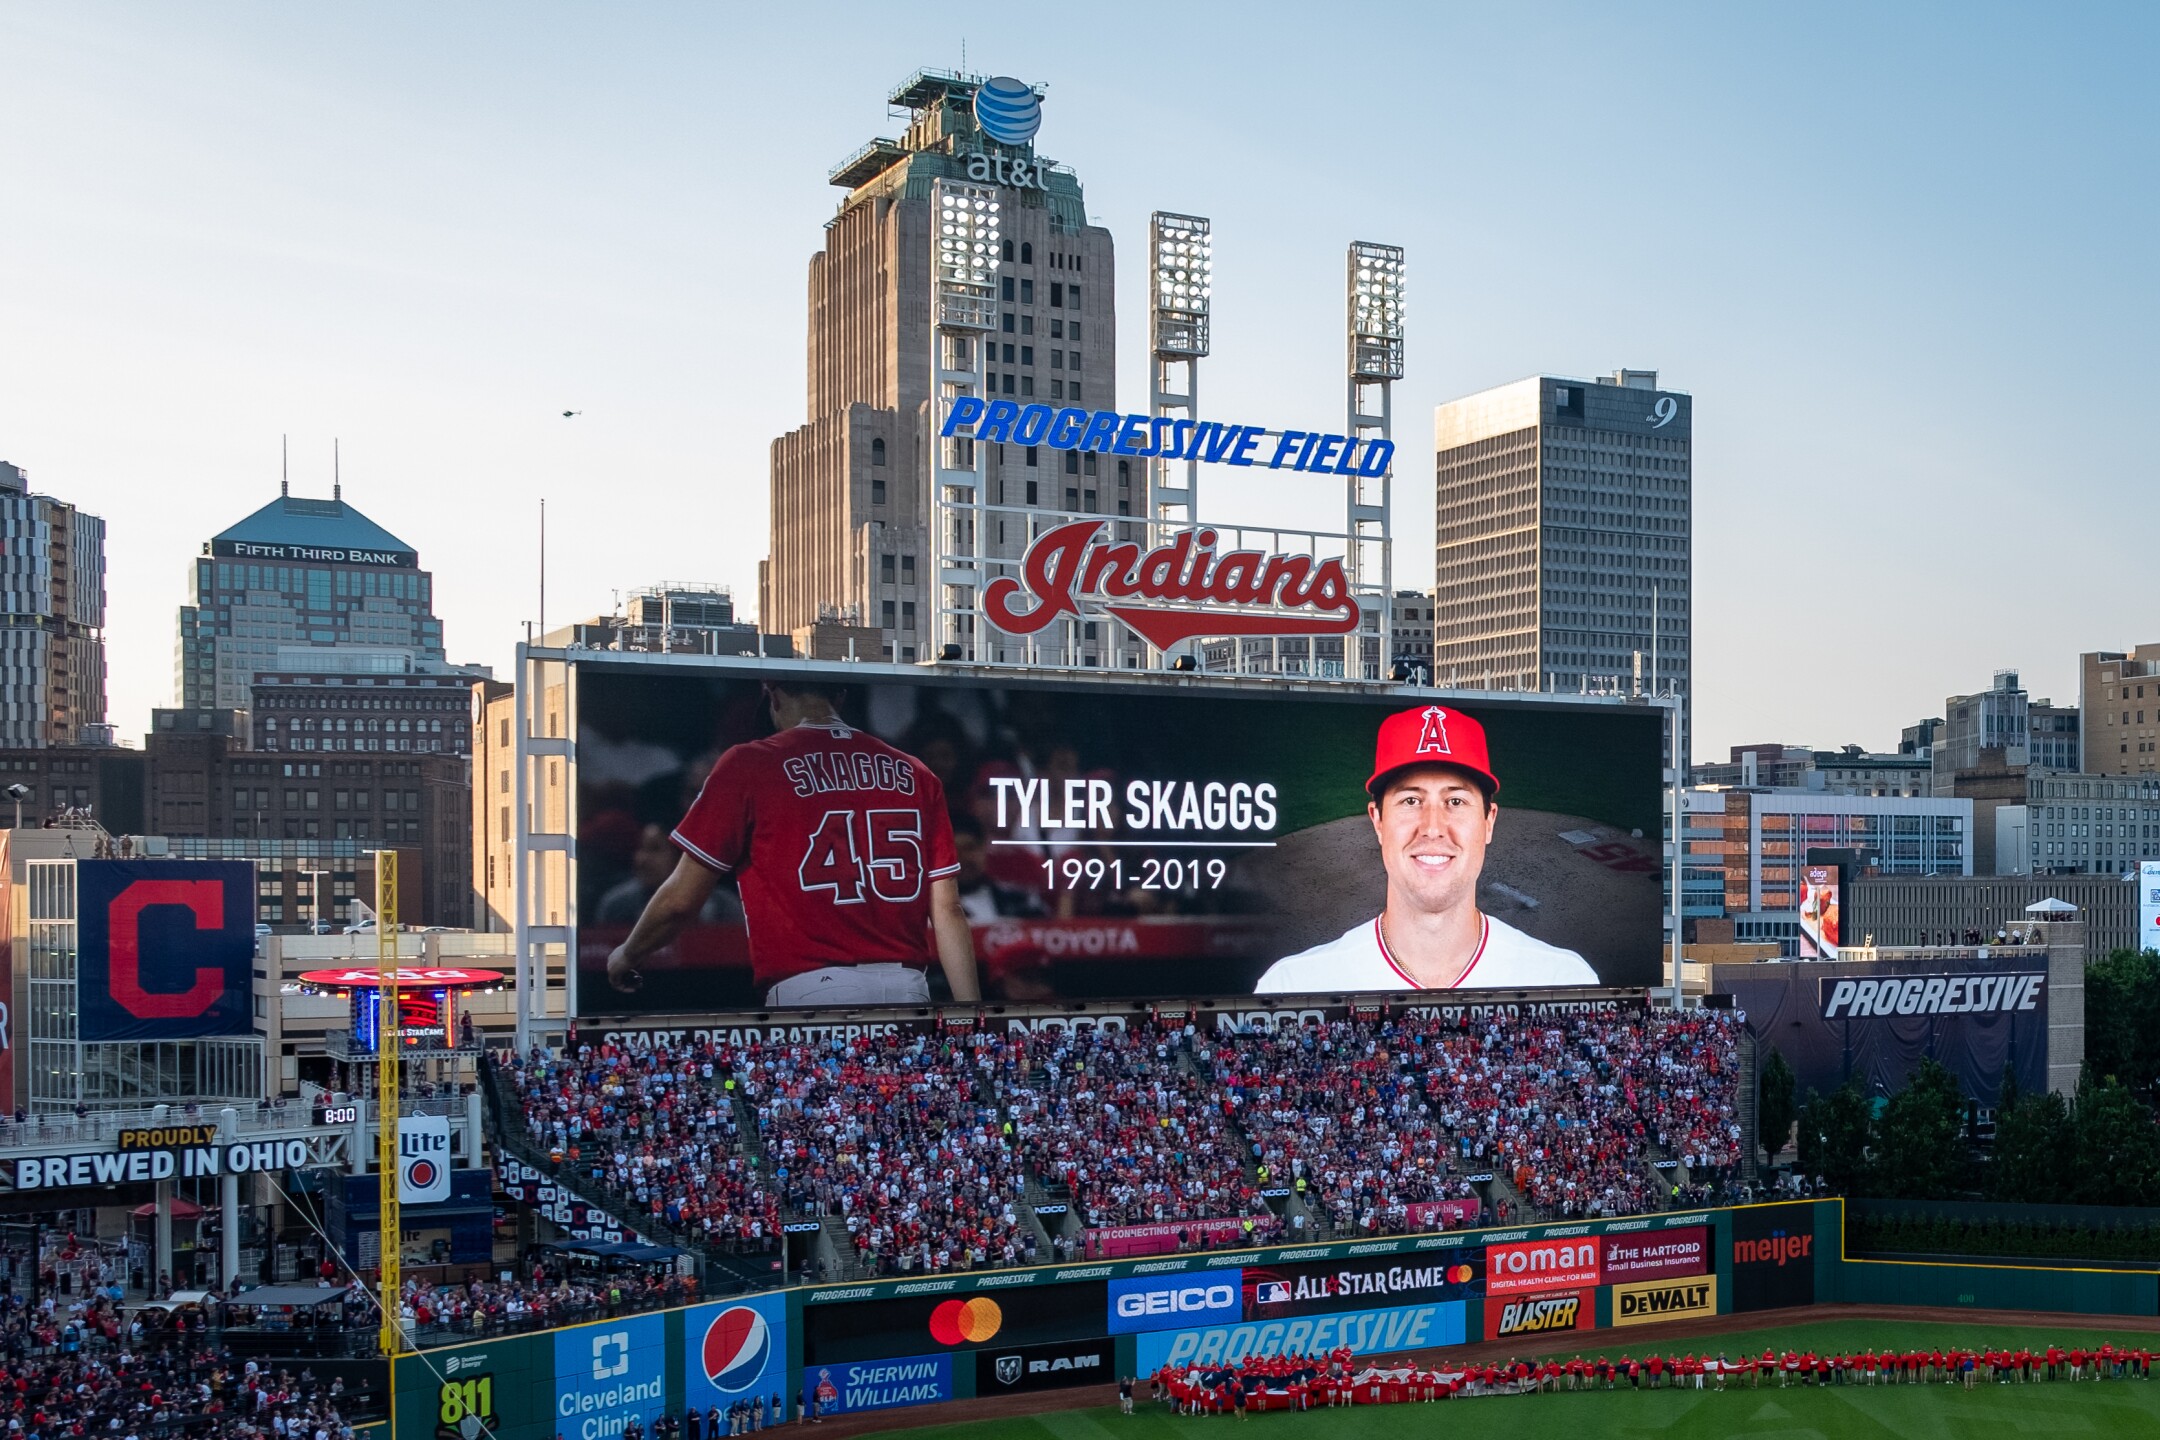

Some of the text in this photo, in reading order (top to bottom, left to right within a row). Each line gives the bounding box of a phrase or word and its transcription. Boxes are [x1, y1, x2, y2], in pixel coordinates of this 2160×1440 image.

[966, 150, 1049, 191] at&t
[1652, 396, 1678, 429] 9
[941, 396, 1395, 478] PROGRESSIVE FIELD
[234, 542, 398, 564] FIFTH THIRD BANK
[981, 516, 1361, 654] Indians
[1415, 706, 1452, 755] A
[783, 752, 915, 798] SKAGGS
[989, 777, 1277, 830] TYLER SKAGGS
[799, 809, 924, 905] 45
[1041, 858, 1226, 890] 1991-2019
[109, 880, 224, 1019] C
[1031, 928, 1138, 954] TOYOTA
[1825, 975, 2045, 1018] PROGRESSIVE
[1008, 1016, 1125, 1038] NOCO
[1217, 1010, 1325, 1034] NOCO
[325, 1108, 355, 1123] 8:00
[120, 1124, 217, 1149] PROUDLY
[399, 1132, 446, 1158] Lite
[16, 1139, 307, 1190] BREWED IN OHIO
[1466, 1174, 1493, 1182] NOCO
[1260, 1188, 1290, 1197] NOCO
[1034, 1205, 1067, 1214] NOCO
[1665, 1214, 1709, 1226] PROGRESSIVE
[784, 1223, 820, 1232] NOCO
[1111, 1226, 1170, 1239] CONNECTING
[1480, 1230, 1530, 1243] PROGRESSIVE
[1544, 1225, 1591, 1237] PROGRESSIVE
[1605, 1220, 1651, 1232] PROGRESSIVE
[1278, 1248, 1332, 1260] PROGRESSIVE
[1348, 1242, 1400, 1255] PROGRESSIVE
[1416, 1236, 1465, 1248] PROGRESSIVE
[1618, 1242, 1700, 1259] THE HARTFORD
[1734, 1230, 1812, 1266] meijer
[1132, 1260, 1190, 1274] PROGRESSIVE
[1206, 1253, 1262, 1266] PROGRESSIVE
[1493, 1244, 1595, 1275] roman
[1607, 1256, 1700, 1271] Small Business Insurance
[976, 1273, 1038, 1287] PROGRESSIVE
[1056, 1266, 1114, 1280] PROGRESSIVE
[1295, 1266, 1444, 1300] ALL STAR GAME
[1518, 1278, 1543, 1286] HEALTH
[1544, 1275, 1566, 1283] CLINIC
[810, 1287, 876, 1301] PROGRESSIVE
[894, 1280, 958, 1294] PROGRESSIVE
[1117, 1285, 1234, 1318] GEICO
[1166, 1307, 1436, 1369] PROGRESSIVE
[846, 1361, 938, 1387] SHERWIN
[1029, 1354, 1100, 1373] RAM
[440, 1377, 491, 1424] 811
[559, 1375, 661, 1417] Cleveland
[845, 1382, 939, 1409] WILLIAMS
[582, 1409, 641, 1440] Clinic
